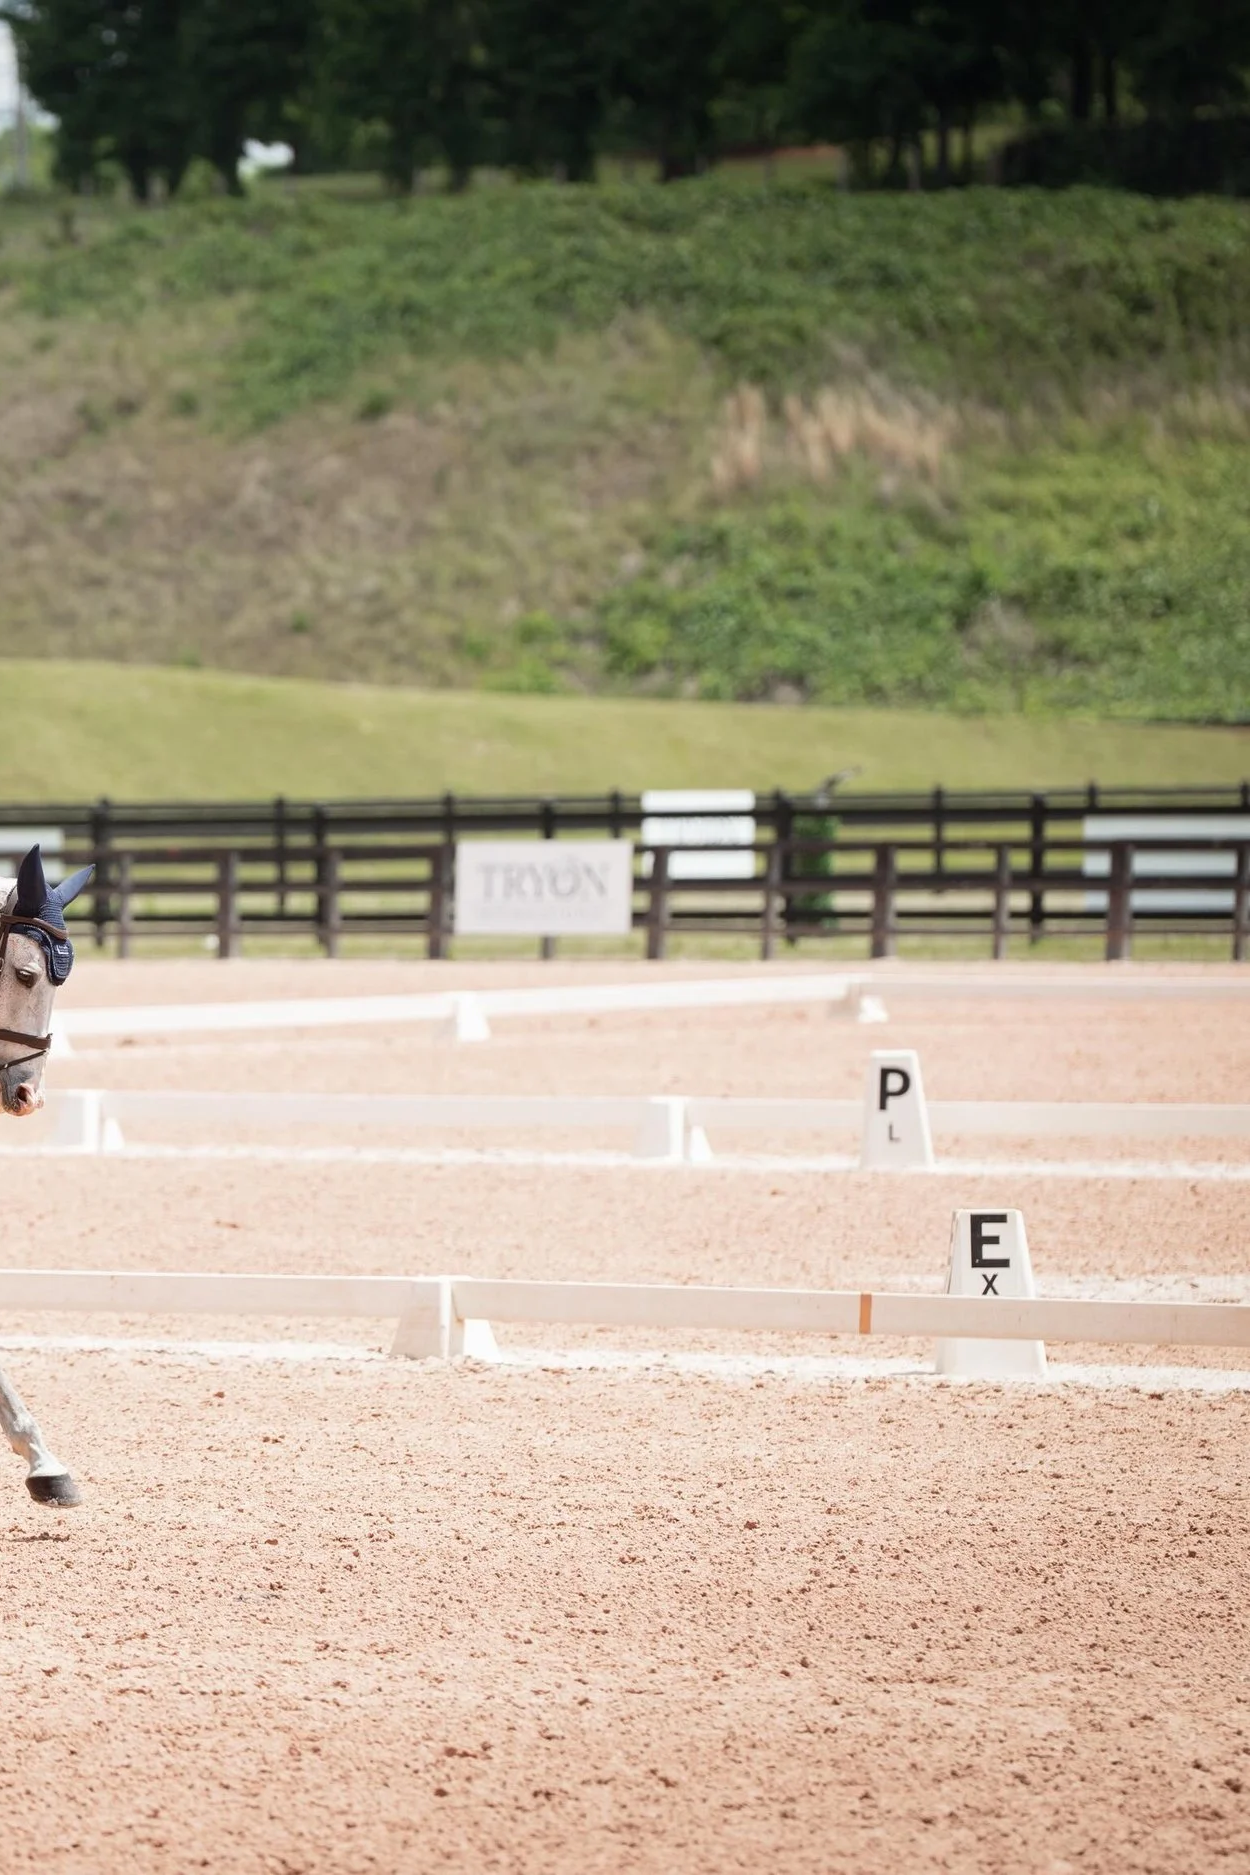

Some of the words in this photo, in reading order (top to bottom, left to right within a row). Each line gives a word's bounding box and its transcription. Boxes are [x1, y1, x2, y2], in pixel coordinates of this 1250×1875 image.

[476, 858, 611, 901] TRYON
[879, 1067, 911, 1110] P
[888, 1123, 901, 1141] L
[970, 1214, 1010, 1268] E
[982, 1274, 999, 1295] X
